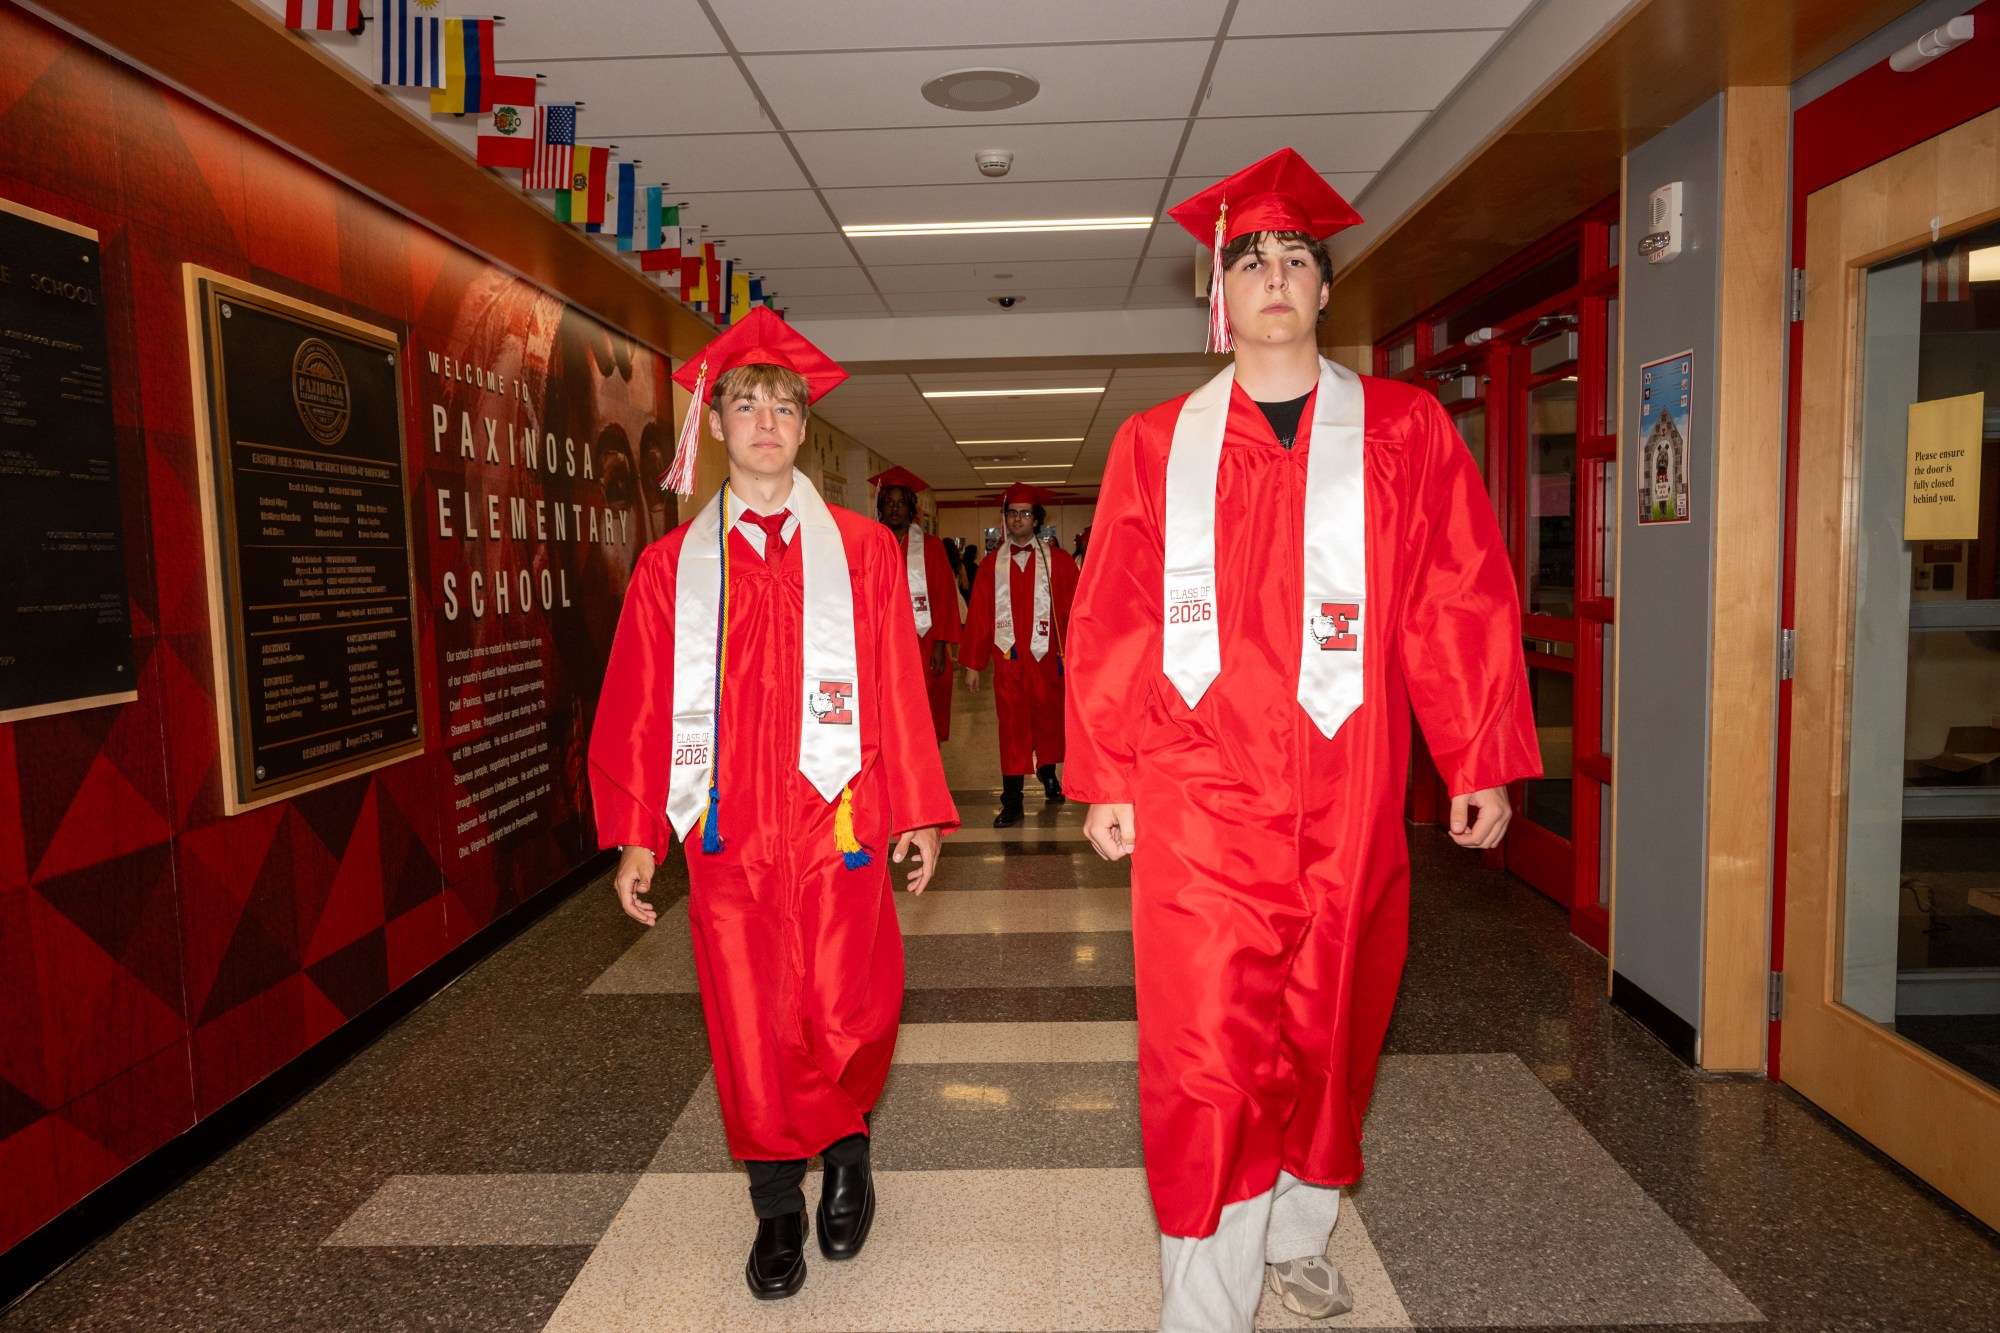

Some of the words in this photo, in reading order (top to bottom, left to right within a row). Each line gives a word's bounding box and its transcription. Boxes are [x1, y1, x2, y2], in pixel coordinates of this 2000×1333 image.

[30, 273, 96, 305] SCHOOL
[428, 351, 504, 395] WELCOME
[514, 380, 529, 402] TO
[432, 404, 593, 480] PAXINOSA
[1915, 451, 1937, 461] Please
[1939, 449, 1964, 459] ensure
[1914, 466, 1924, 475] the
[1926, 465, 1944, 474] door
[1946, 463, 1952, 473] is
[1913, 480, 1929, 491] fully
[1931, 478, 1954, 489] closed
[1913, 493, 1937, 504] behind
[1939, 494, 1956, 505] you.
[438, 488, 627, 544] ELEMENTARY
[443, 569, 570, 620] SCHOOL
[1170, 588, 1198, 600] CLASS
[1200, 586, 1210, 597] OF
[1169, 602, 1212, 624] 2026
[997, 620, 1012, 630] 2026
[456, 648, 473, 661] school's
[474, 647, 485, 657] name
[485, 646, 489, 655] is
[448, 676, 453, 687] of
[462, 670, 481, 683] country's
[450, 700, 460, 712] Chief
[451, 723, 470, 736] Shawnee
[676, 733, 700, 744] CLASS
[452, 749, 461, 761] and
[462, 746, 471, 758] 18th
[494, 736, 500, 746] He
[675, 747, 708, 765] 2026
[454, 771, 473, 786] Shawnee
[480, 786, 494, 800] eastern
[494, 780, 506, 793] United
[521, 771, 526, 781] He
